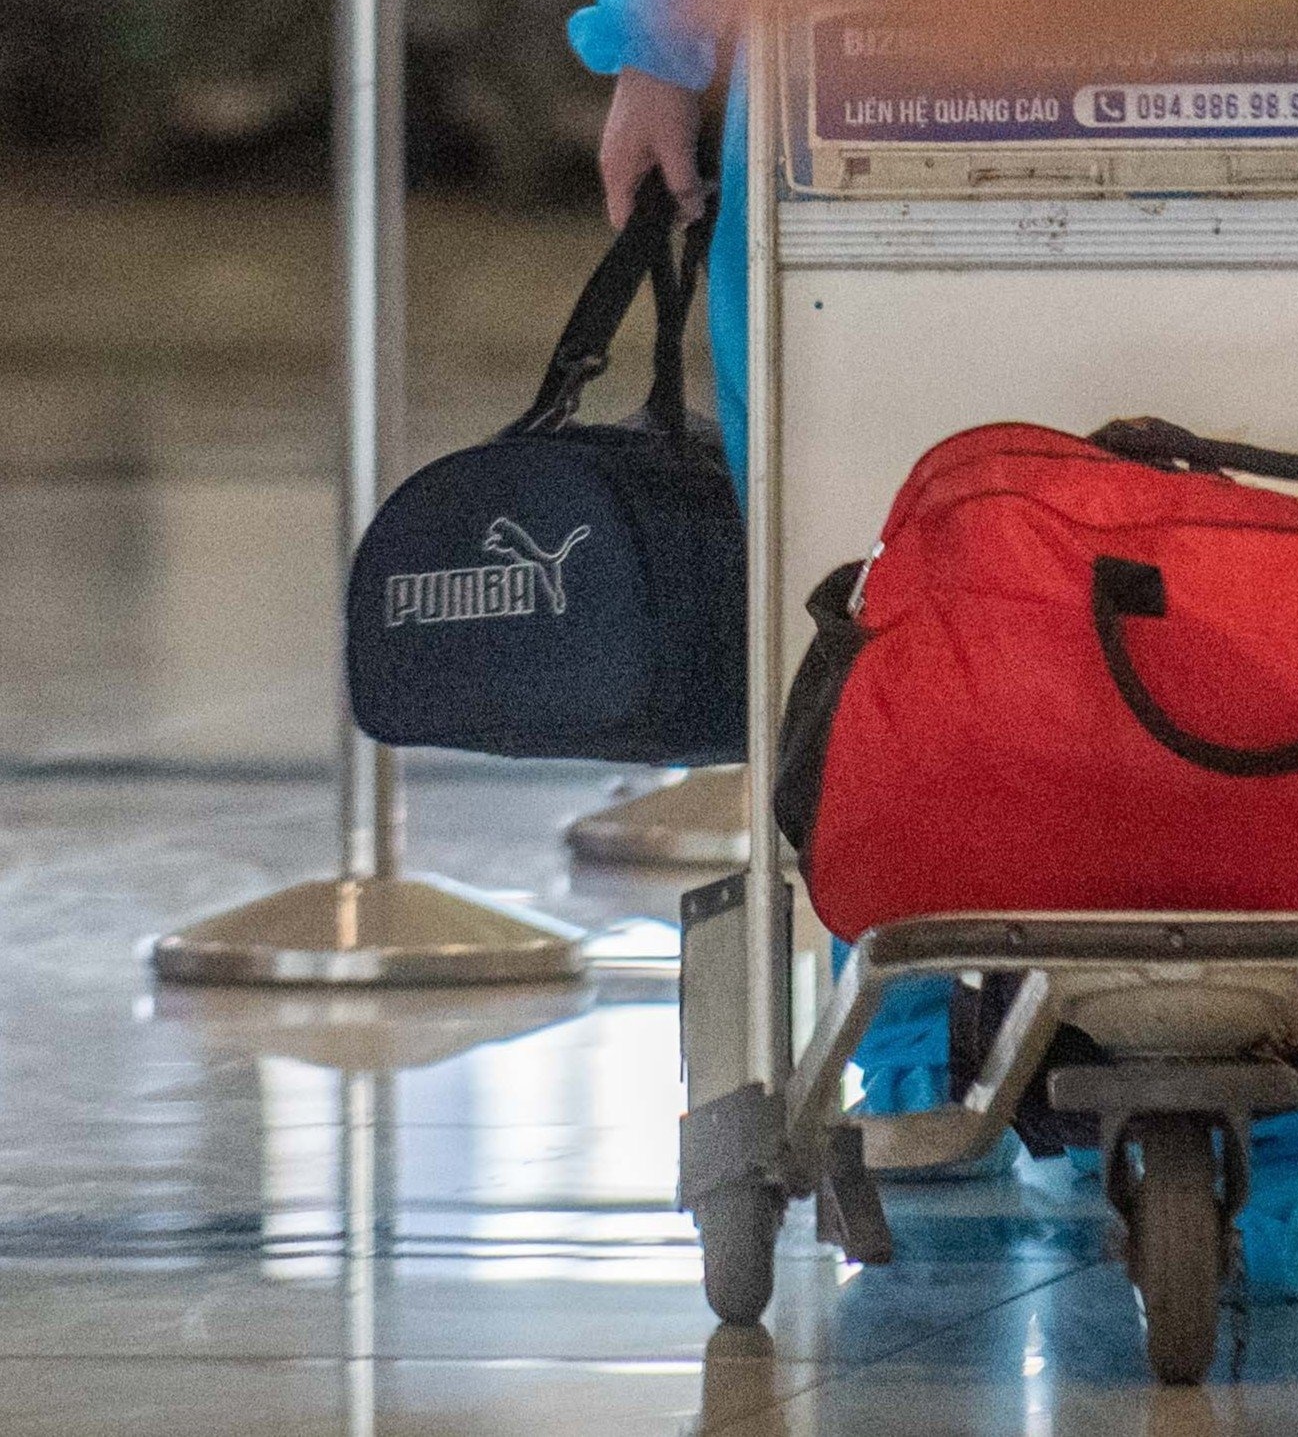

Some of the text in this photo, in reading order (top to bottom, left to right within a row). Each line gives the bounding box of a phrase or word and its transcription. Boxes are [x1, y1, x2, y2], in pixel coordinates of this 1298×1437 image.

[844, 96, 893, 125] LIÊN
[900, 93, 928, 128] HỆ
[935, 92, 1010, 124] QUẢNG
[1015, 93, 1060, 123] CÁO
